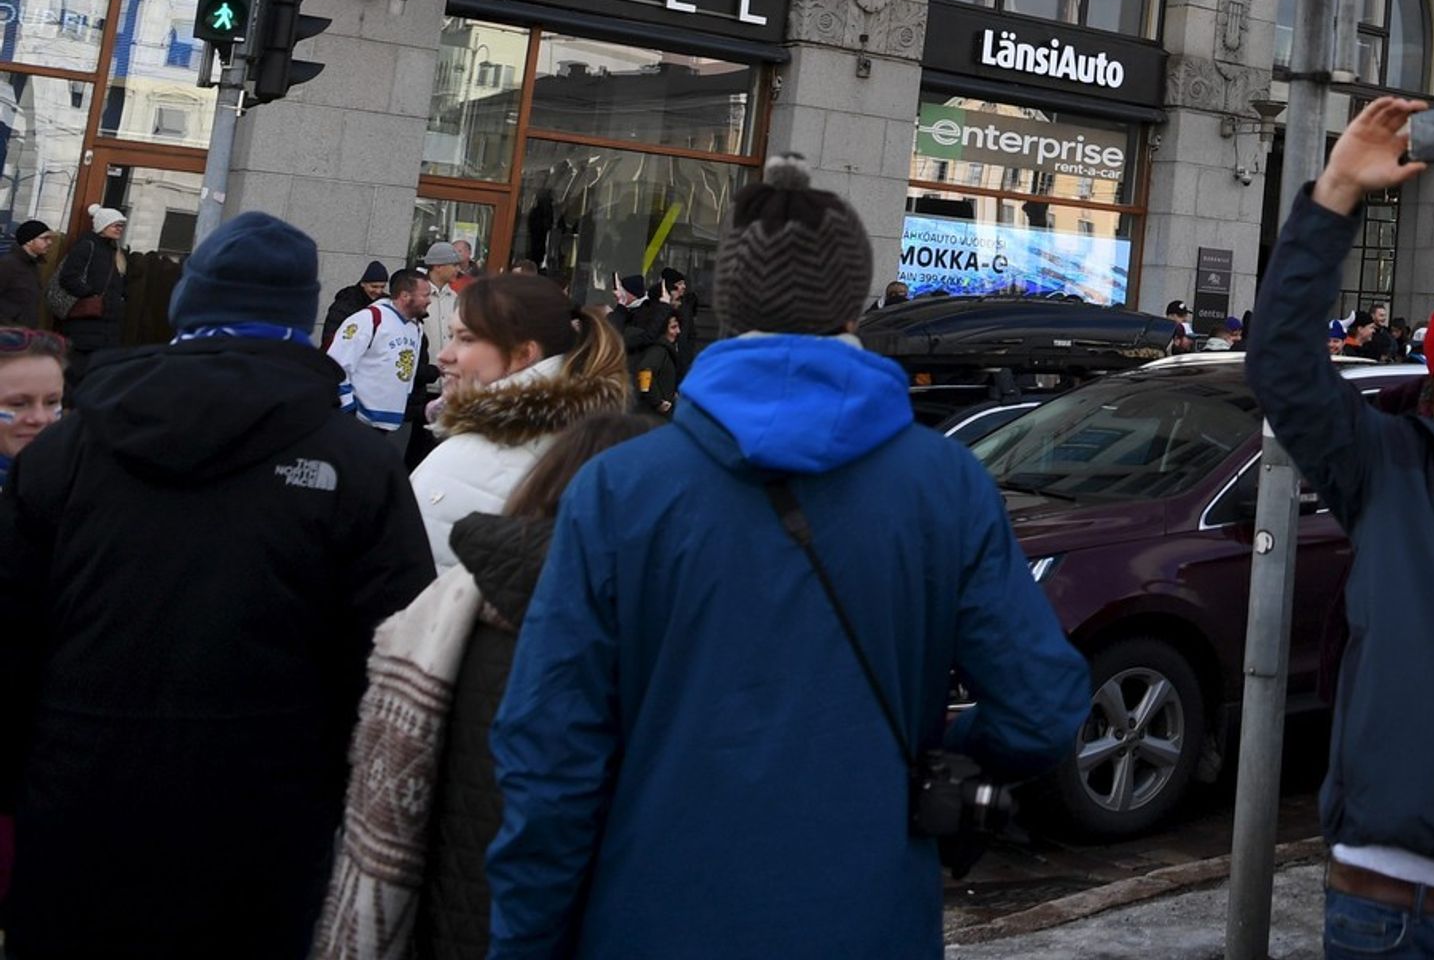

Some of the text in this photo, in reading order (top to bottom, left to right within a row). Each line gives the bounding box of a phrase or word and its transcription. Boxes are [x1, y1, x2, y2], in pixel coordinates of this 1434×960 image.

[981, 29, 1125, 88] LänsiAuto
[929, 119, 1124, 168] enterprise
[1054, 161, 1122, 180] rent-a-car
